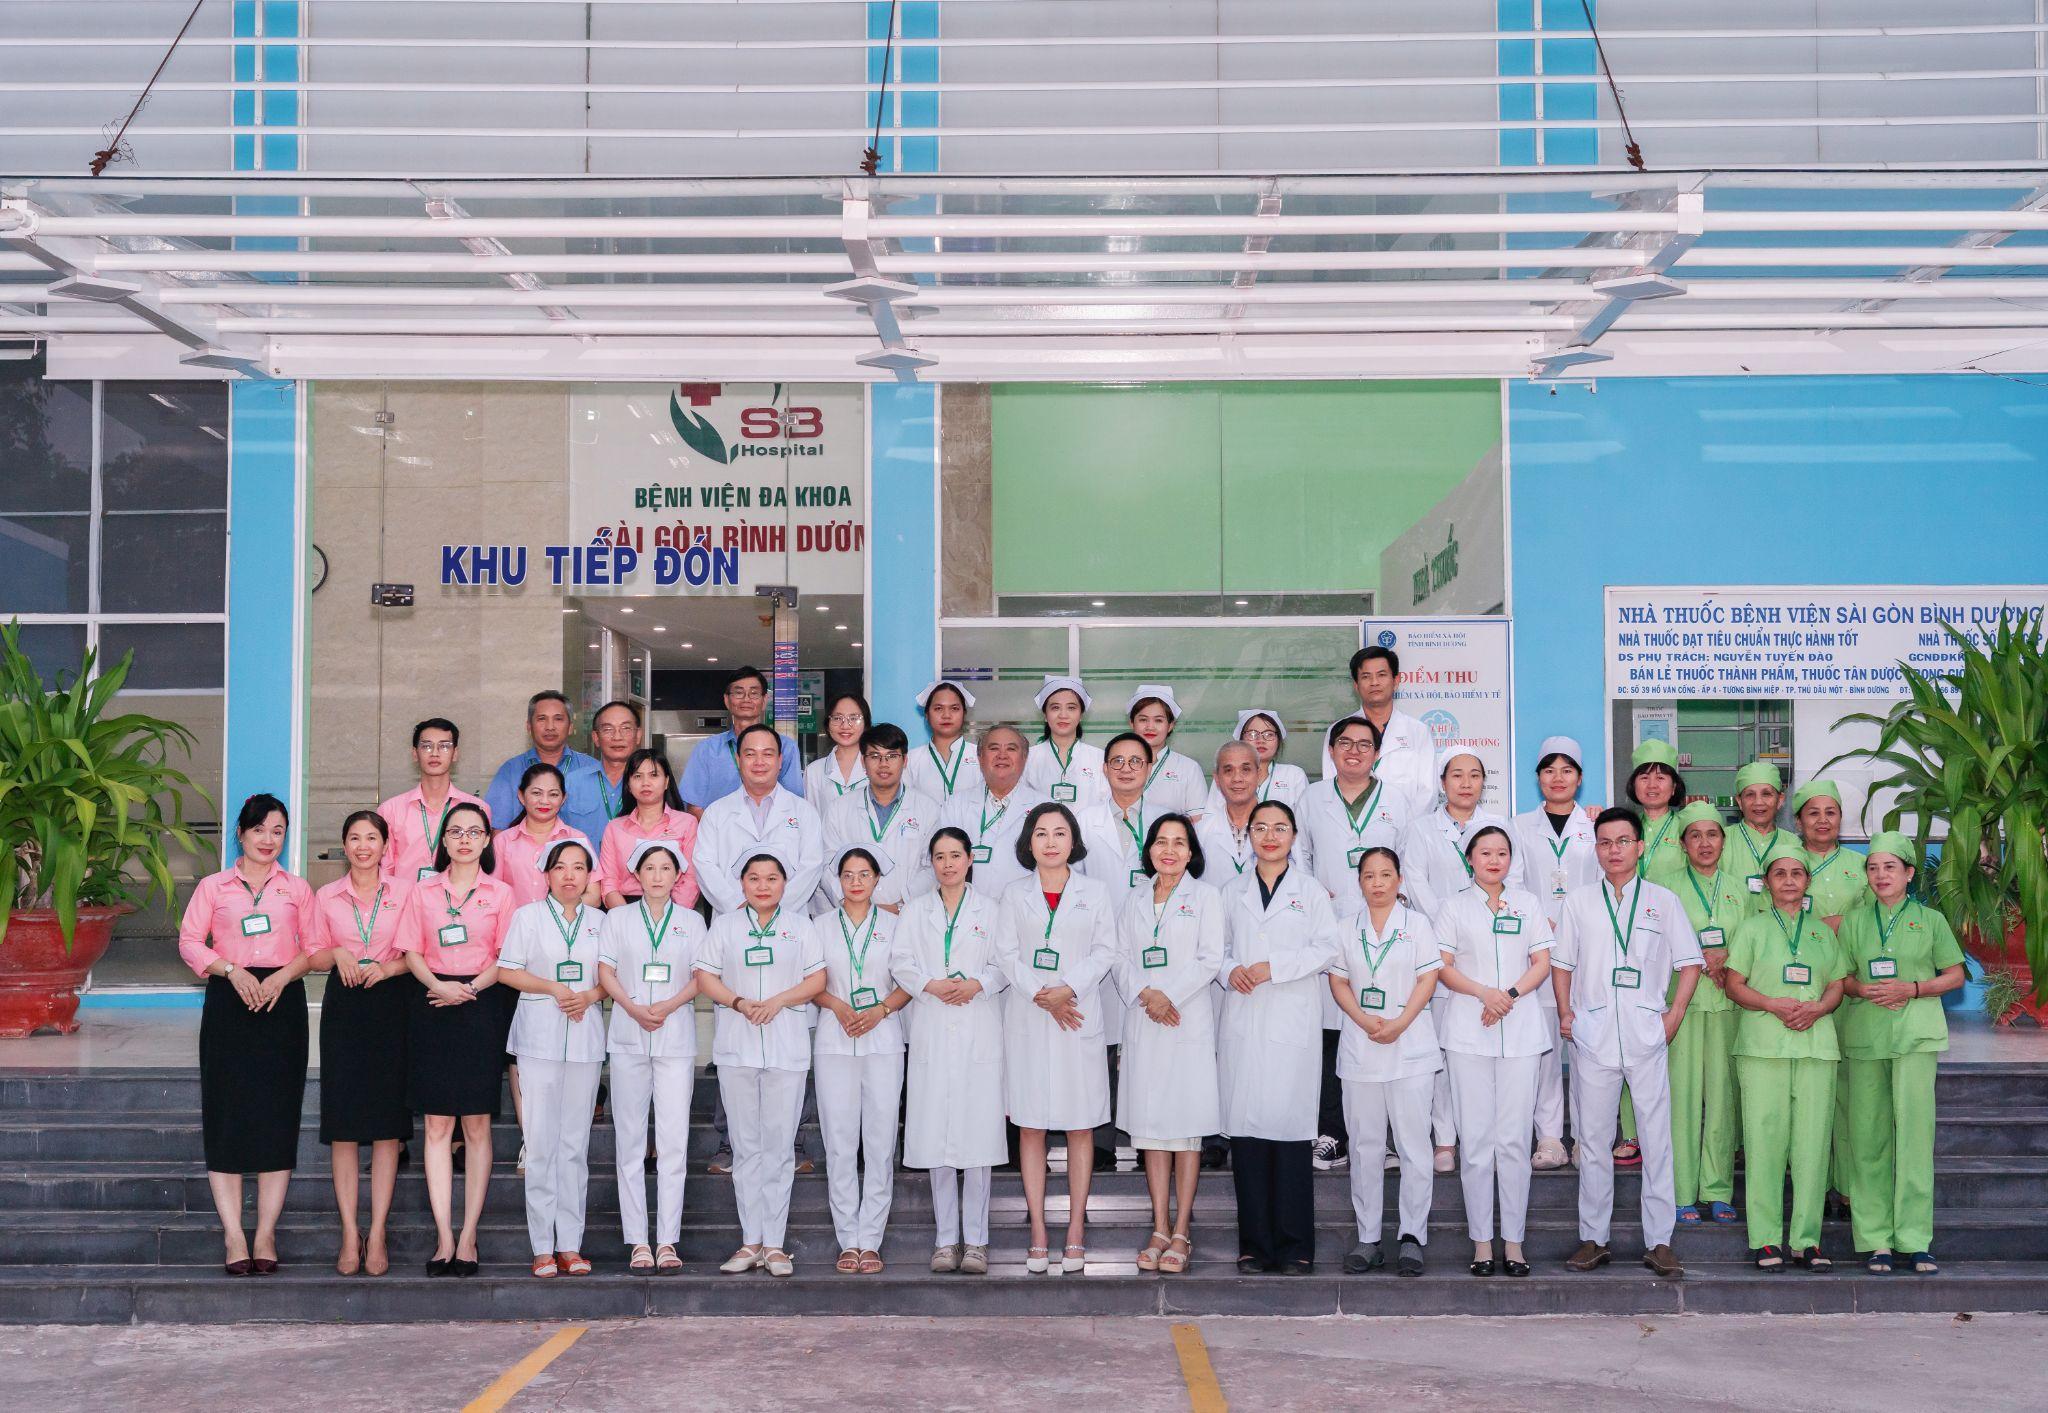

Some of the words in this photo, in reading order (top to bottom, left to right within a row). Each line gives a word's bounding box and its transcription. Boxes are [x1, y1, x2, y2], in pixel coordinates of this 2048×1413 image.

[741, 407, 824, 438] SB
[741, 444, 824, 458] Hospital
[635, 483, 692, 512] BỆNH
[701, 483, 751, 512] VIỆN
[758, 487, 787, 507] ĐA
[795, 486, 852, 507] KHOA
[441, 545, 527, 586] KHU
[545, 529, 638, 585] TIẾP
[654, 533, 739, 586] ĐÓN
[1618, 602, 1657, 623] NHÀ
[1663, 600, 1725, 623] THUỐC
[1731, 602, 1781, 627] BỆNH
[1787, 602, 1831, 627] VIỆN
[1836, 603, 1867, 624] SÀI
[1872, 603, 1914, 624] GÒN
[1920, 602, 1965, 623] BÌNH
[1618, 630, 1640, 646] NHÀ
[1644, 628, 1679, 646] THUỐC
[1682, 633, 1703, 648] ĐẠT
[1707, 630, 1731, 646] TIÊU
[1734, 626, 1770, 646] CHUẨN
[1773, 630, 1802, 648] THỰC
[1805, 630, 1835, 646] HÀNH
[1838, 628, 1858, 646] TỐT
[1918, 630, 1940, 646] NHÀ
[1944, 628, 1979, 646] THỐC
[1618, 653, 1634, 661] DS
[1638, 653, 1662, 663] PHỤ
[1713, 650, 1761, 661] NGUYỄN
[1399, 666, 1439, 683] ĐIỂM
[1444, 671, 1478, 683] THU
[1630, 666, 1654, 680] BÁN
[1657, 664, 1672, 680] LẺ
[1675, 664, 1715, 680] THUỐC
[1718, 665, 1757, 680] THÀNH
[1761, 663, 1798, 682] PHẨM,
[1802, 664, 1841, 680] THUỐC
[1844, 666, 1867, 680] TÂN
[1871, 666, 1902, 682] DƯỢC
[1642, 686, 1650, 694] 39
[1746, 684, 1762, 694] BÌNH
[1849, 684, 1866, 694] BÌNH
